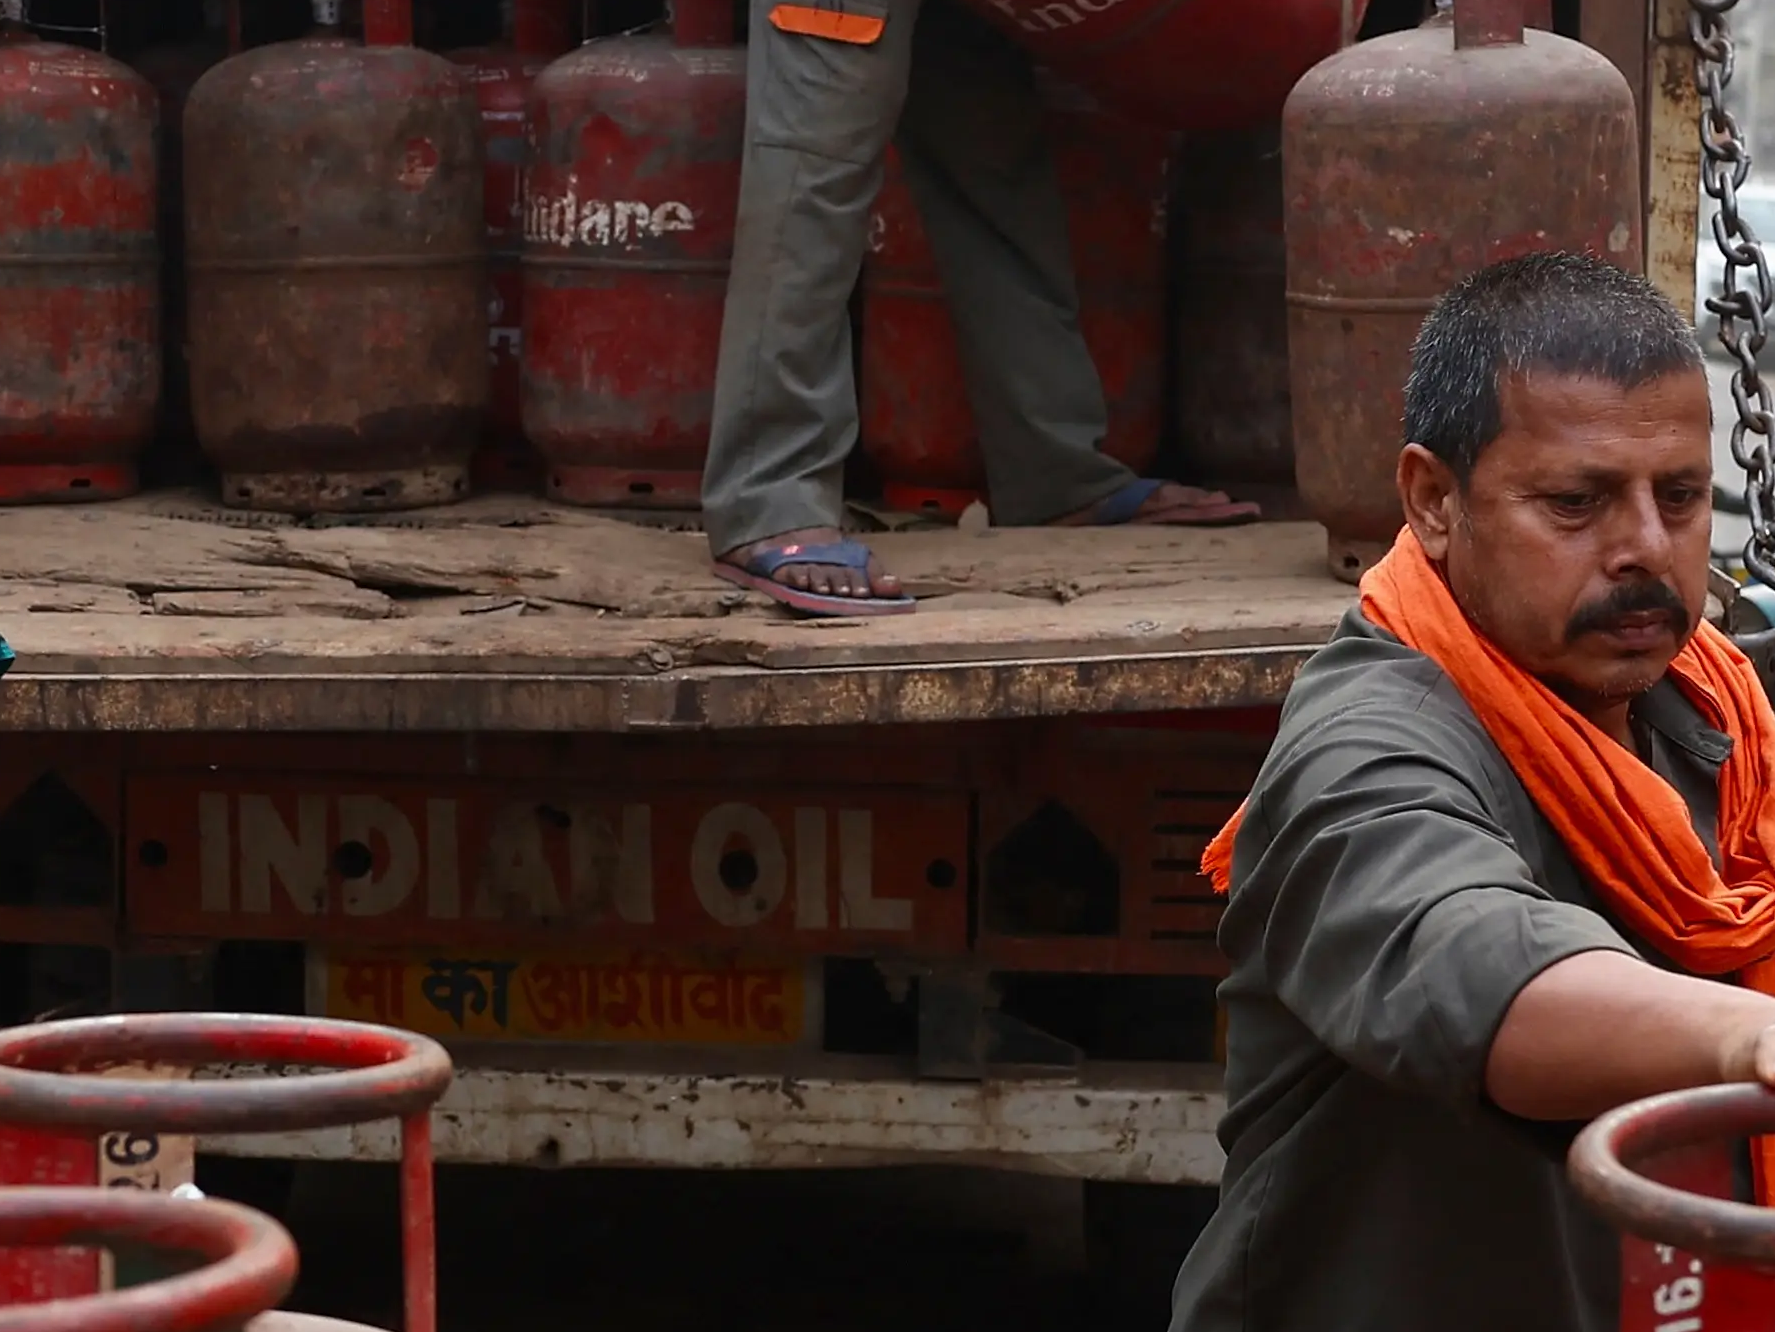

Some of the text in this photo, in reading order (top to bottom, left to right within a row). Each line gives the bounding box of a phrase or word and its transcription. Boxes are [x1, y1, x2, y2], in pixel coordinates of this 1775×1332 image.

[198, 791, 914, 931] INDIAN OIL
[419, 957, 520, 1030] का
